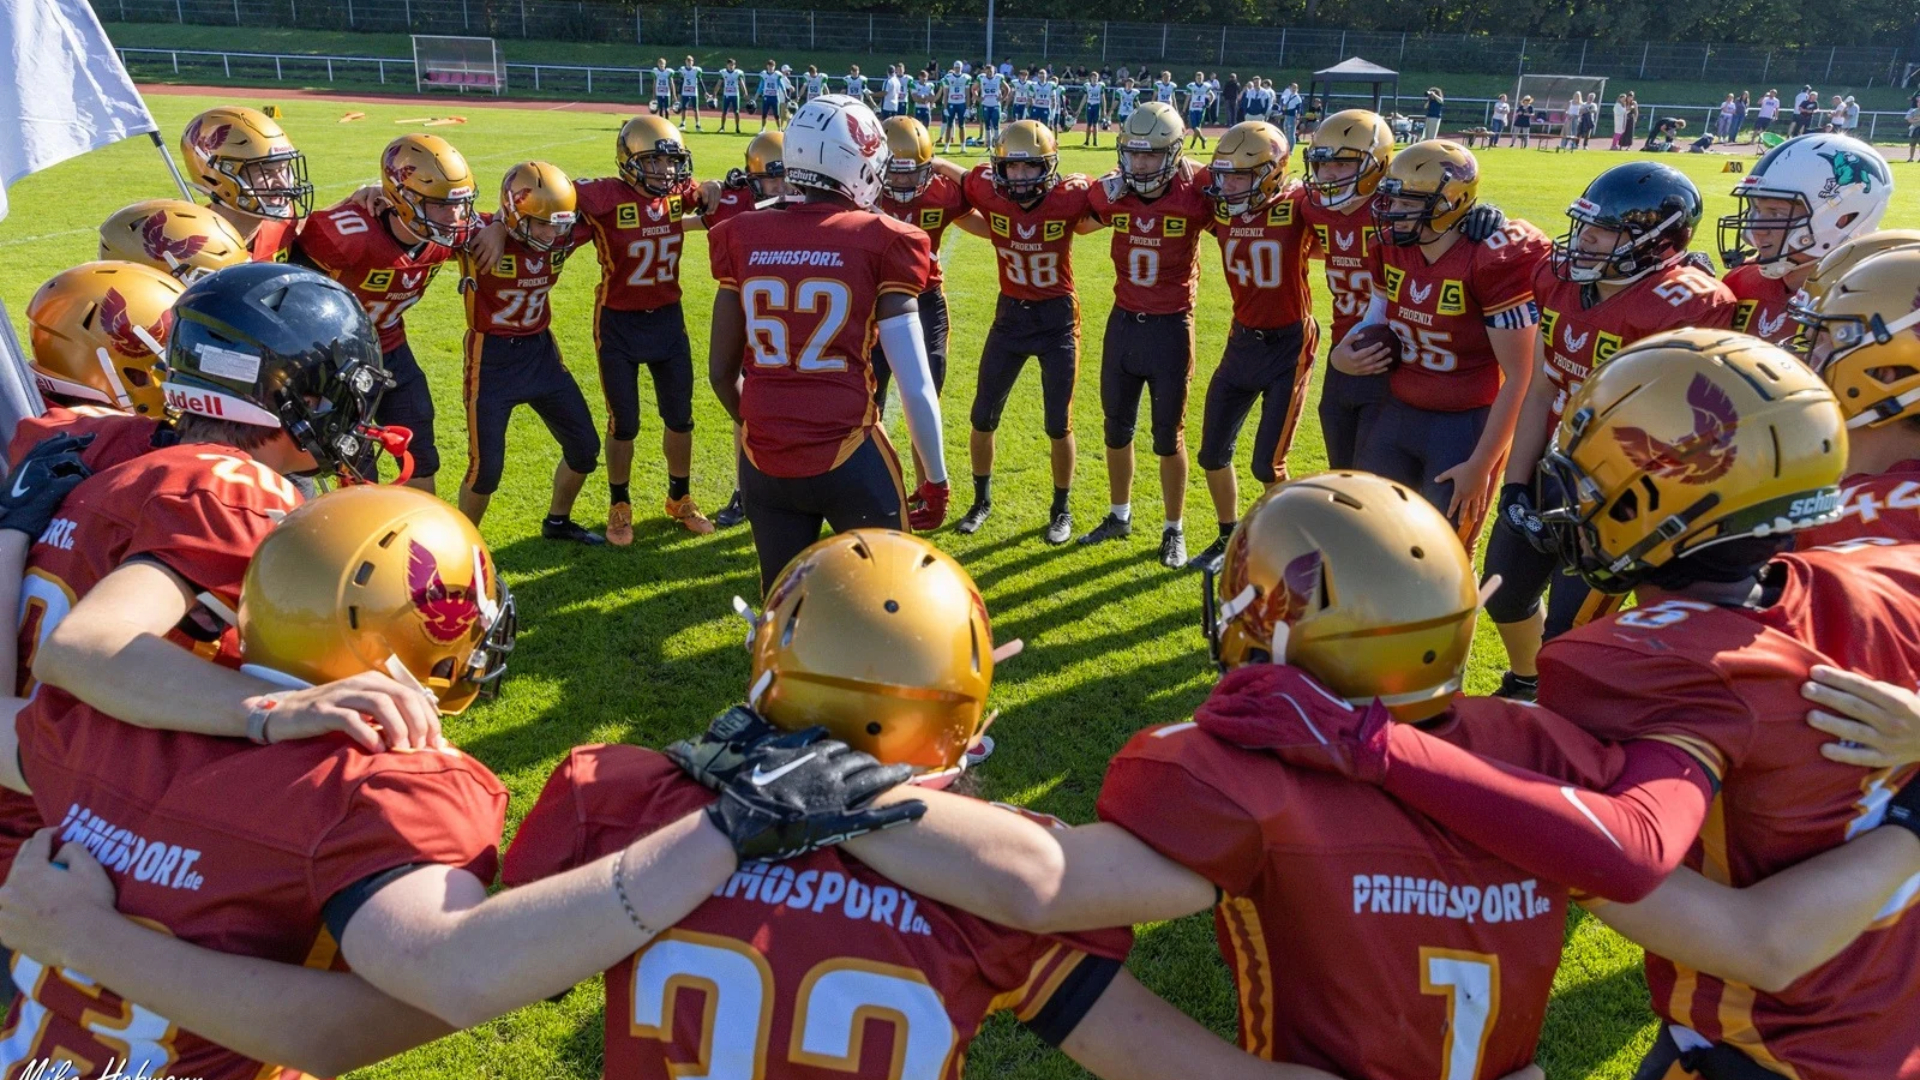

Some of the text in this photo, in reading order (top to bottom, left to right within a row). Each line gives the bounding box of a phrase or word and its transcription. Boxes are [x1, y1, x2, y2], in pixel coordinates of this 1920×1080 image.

[1729, 162, 1742, 173] 30
[642, 225, 672, 237] PHOENIX
[1129, 234, 1162, 246] PHOENIX
[1230, 227, 1264, 237] PHOENIX
[1010, 240, 1043, 251] PHOENIX
[626, 234, 682, 287] 25
[997, 246, 1060, 288] 38
[1128, 247, 1159, 288] 0
[1225, 238, 1282, 288] 40
[1332, 256, 1363, 268] PHOENIX
[517, 275, 549, 288] PHOENIX
[1652, 272, 1718, 307] 50
[491, 287, 550, 328] 28
[1398, 305, 1434, 327] PHOENIX
[742, 275, 853, 373] 62
[1553, 351, 1589, 379] PHOENIX
